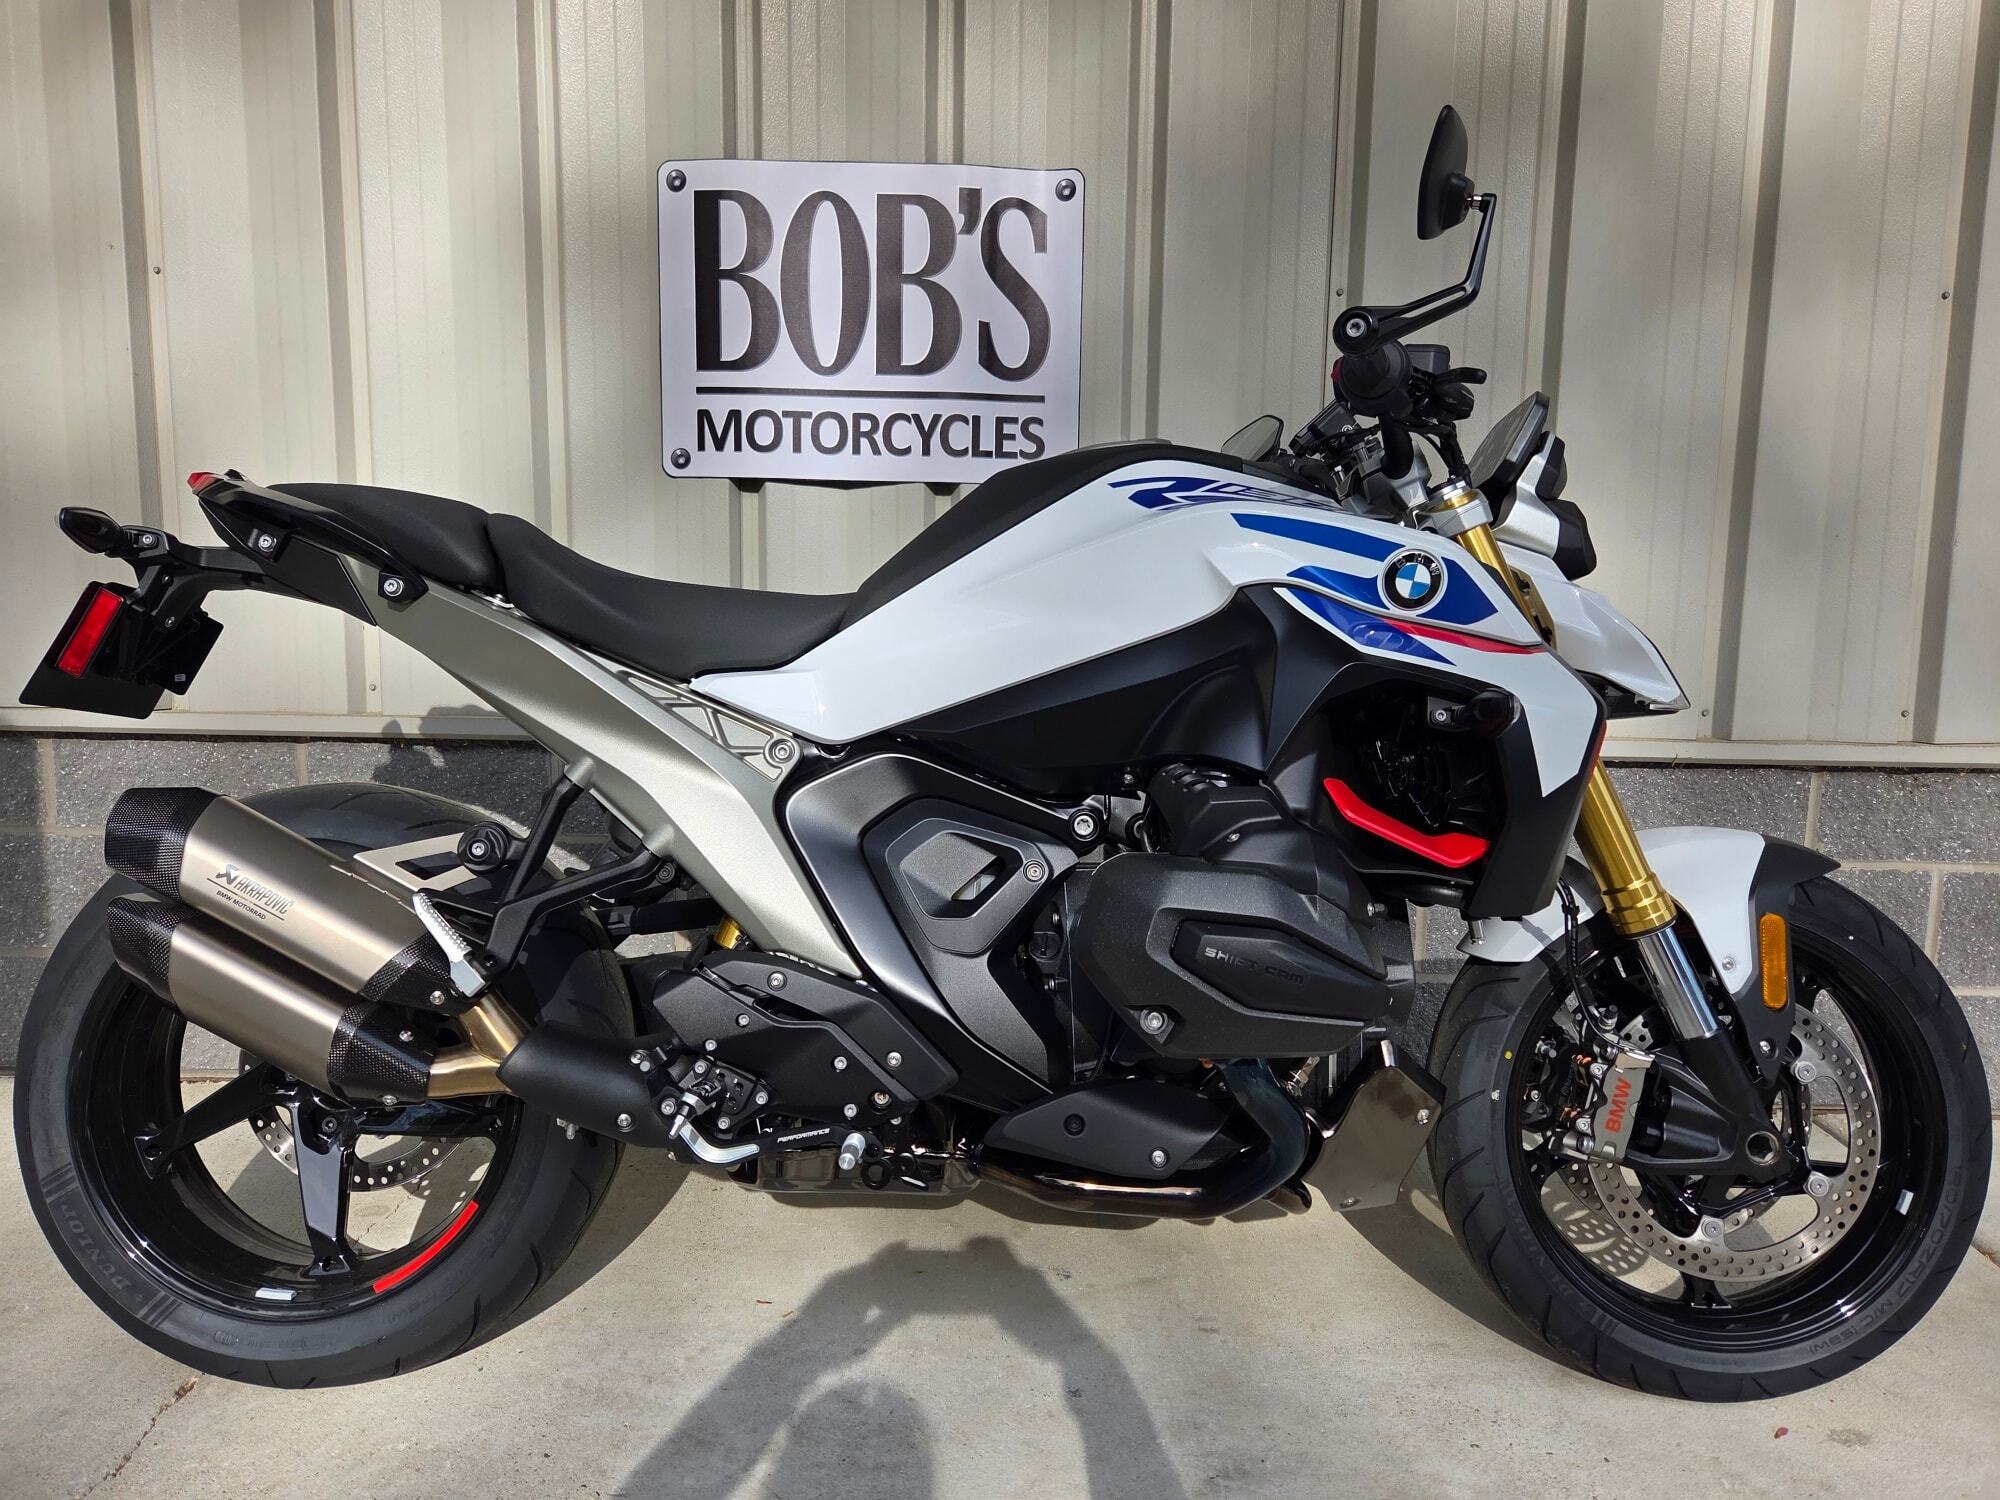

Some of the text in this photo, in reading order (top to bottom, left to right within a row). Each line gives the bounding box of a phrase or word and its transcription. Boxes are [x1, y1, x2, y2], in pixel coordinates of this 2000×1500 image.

[693, 187, 1051, 382] BOB'S
[696, 408, 1046, 461] MOTORCYCLES
[1395, 552, 1440, 576] BMW
[216, 890, 266, 920] BMW MOTORRAD
[1204, 946, 1304, 985] SHIFT CAM
[1604, 1076, 1632, 1133] BMW
[777, 1127, 831, 1144] PERFORMANCE
[61, 1204, 133, 1290] DUNLOP
